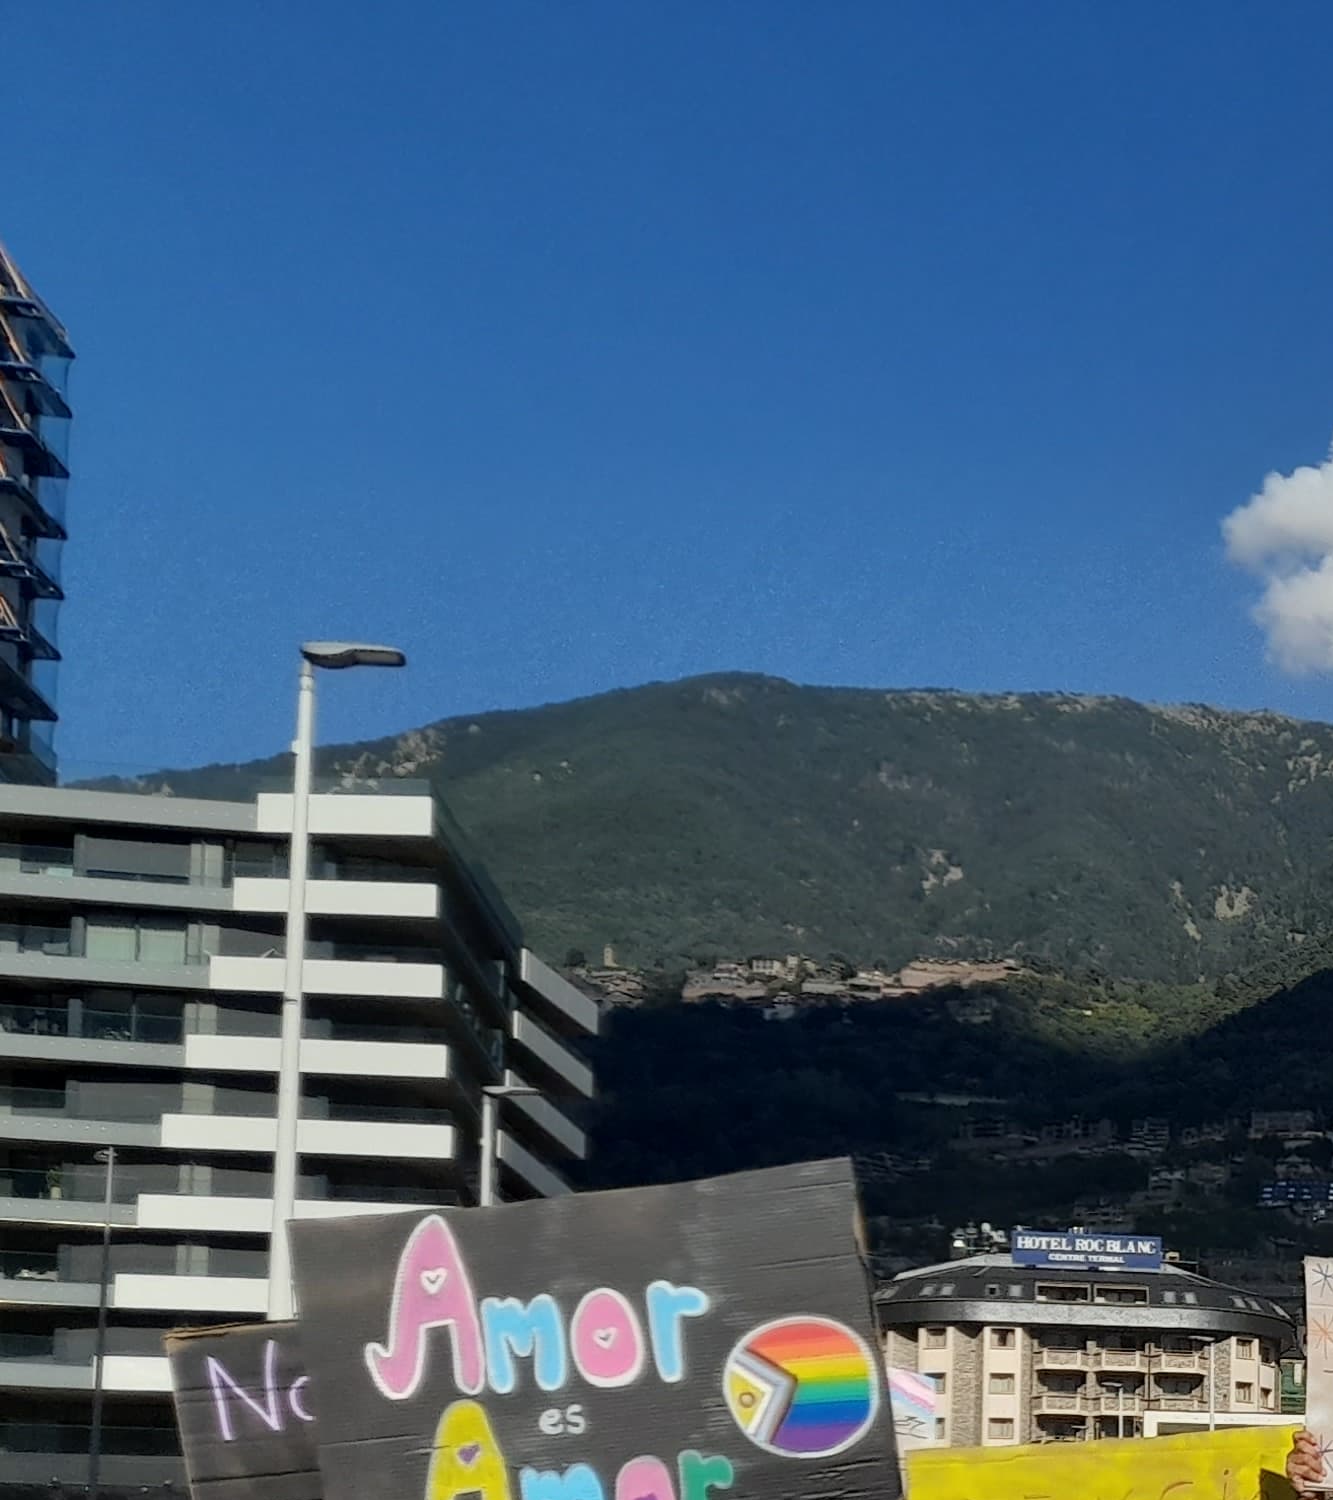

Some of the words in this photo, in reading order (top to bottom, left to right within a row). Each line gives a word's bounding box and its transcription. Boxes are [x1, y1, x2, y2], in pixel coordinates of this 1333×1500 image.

[1016, 1236, 1072, 1251] HOTEL
[1075, 1238, 1105, 1252] ROC
[1106, 1239, 1157, 1255] BLANC
[1048, 1253, 1086, 1263] CENTRE
[538, 1404, 587, 1435] es
